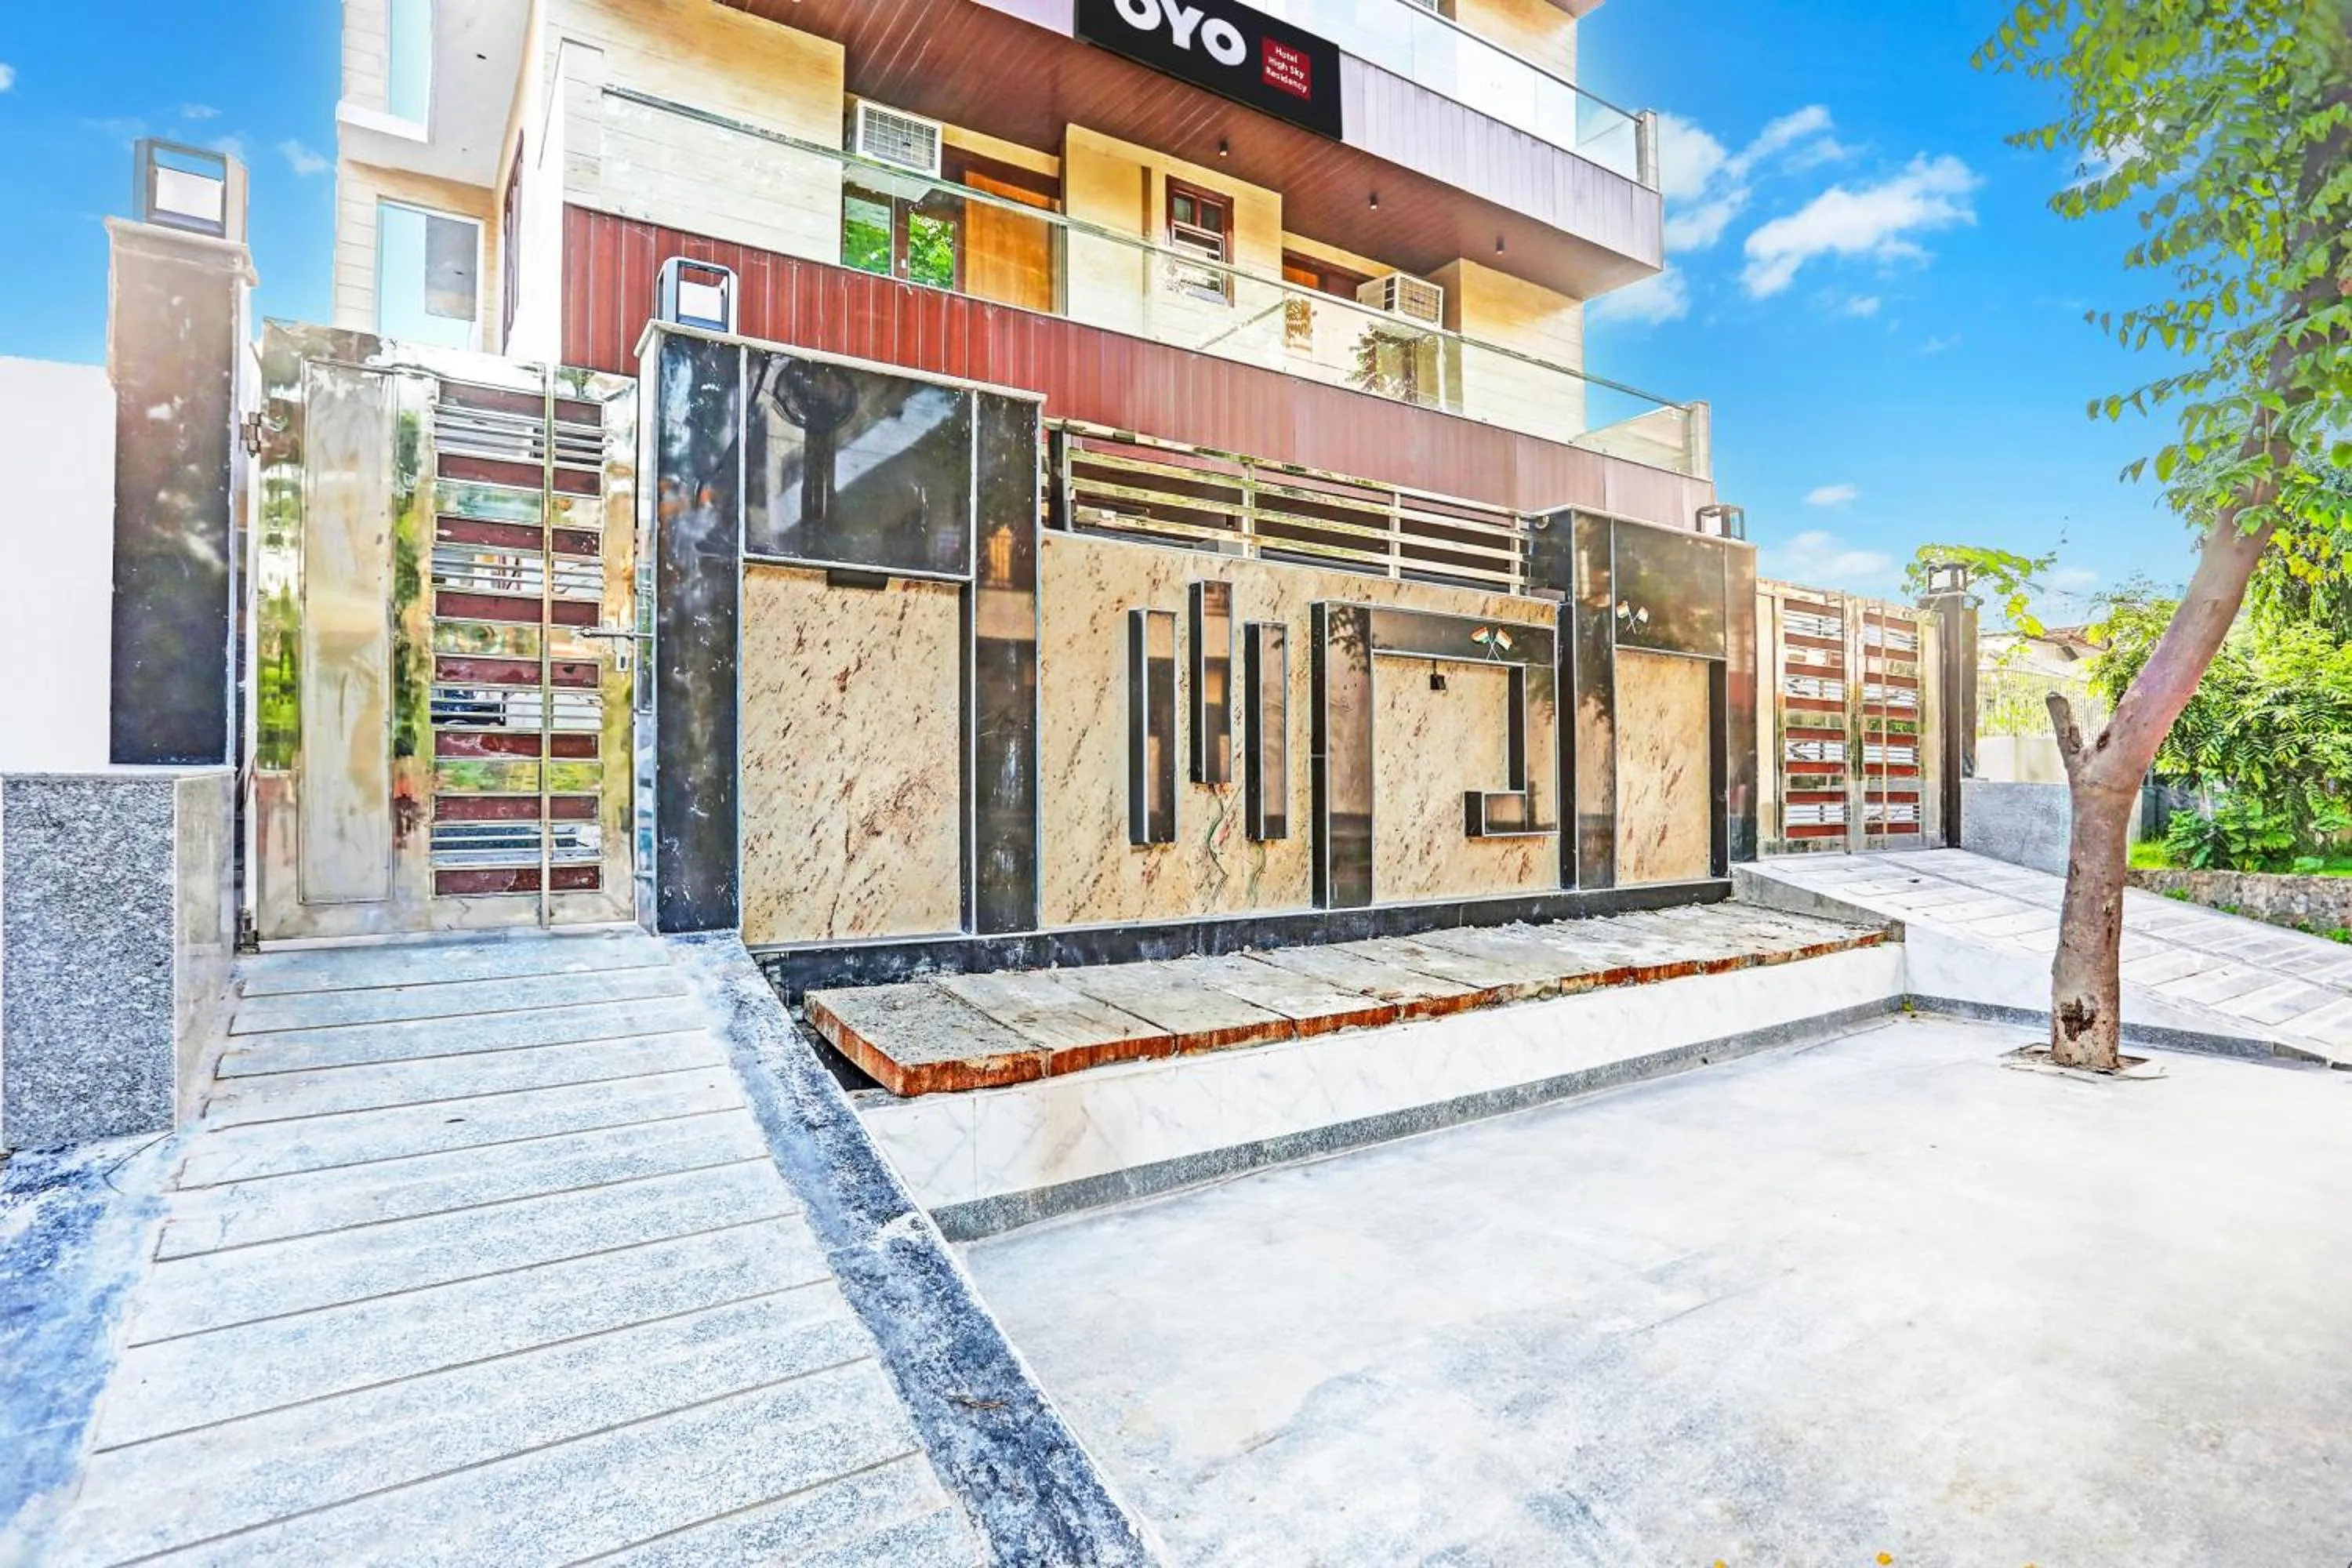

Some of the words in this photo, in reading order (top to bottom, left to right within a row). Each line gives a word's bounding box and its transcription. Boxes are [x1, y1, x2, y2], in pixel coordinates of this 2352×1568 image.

[1114, 0, 1247, 67] OYO
[1268, 56, 1288, 71] High
[1290, 65, 1305, 79] Sky
[1276, 46, 1298, 64] Hotel
[1265, 66, 1308, 93] Residency
